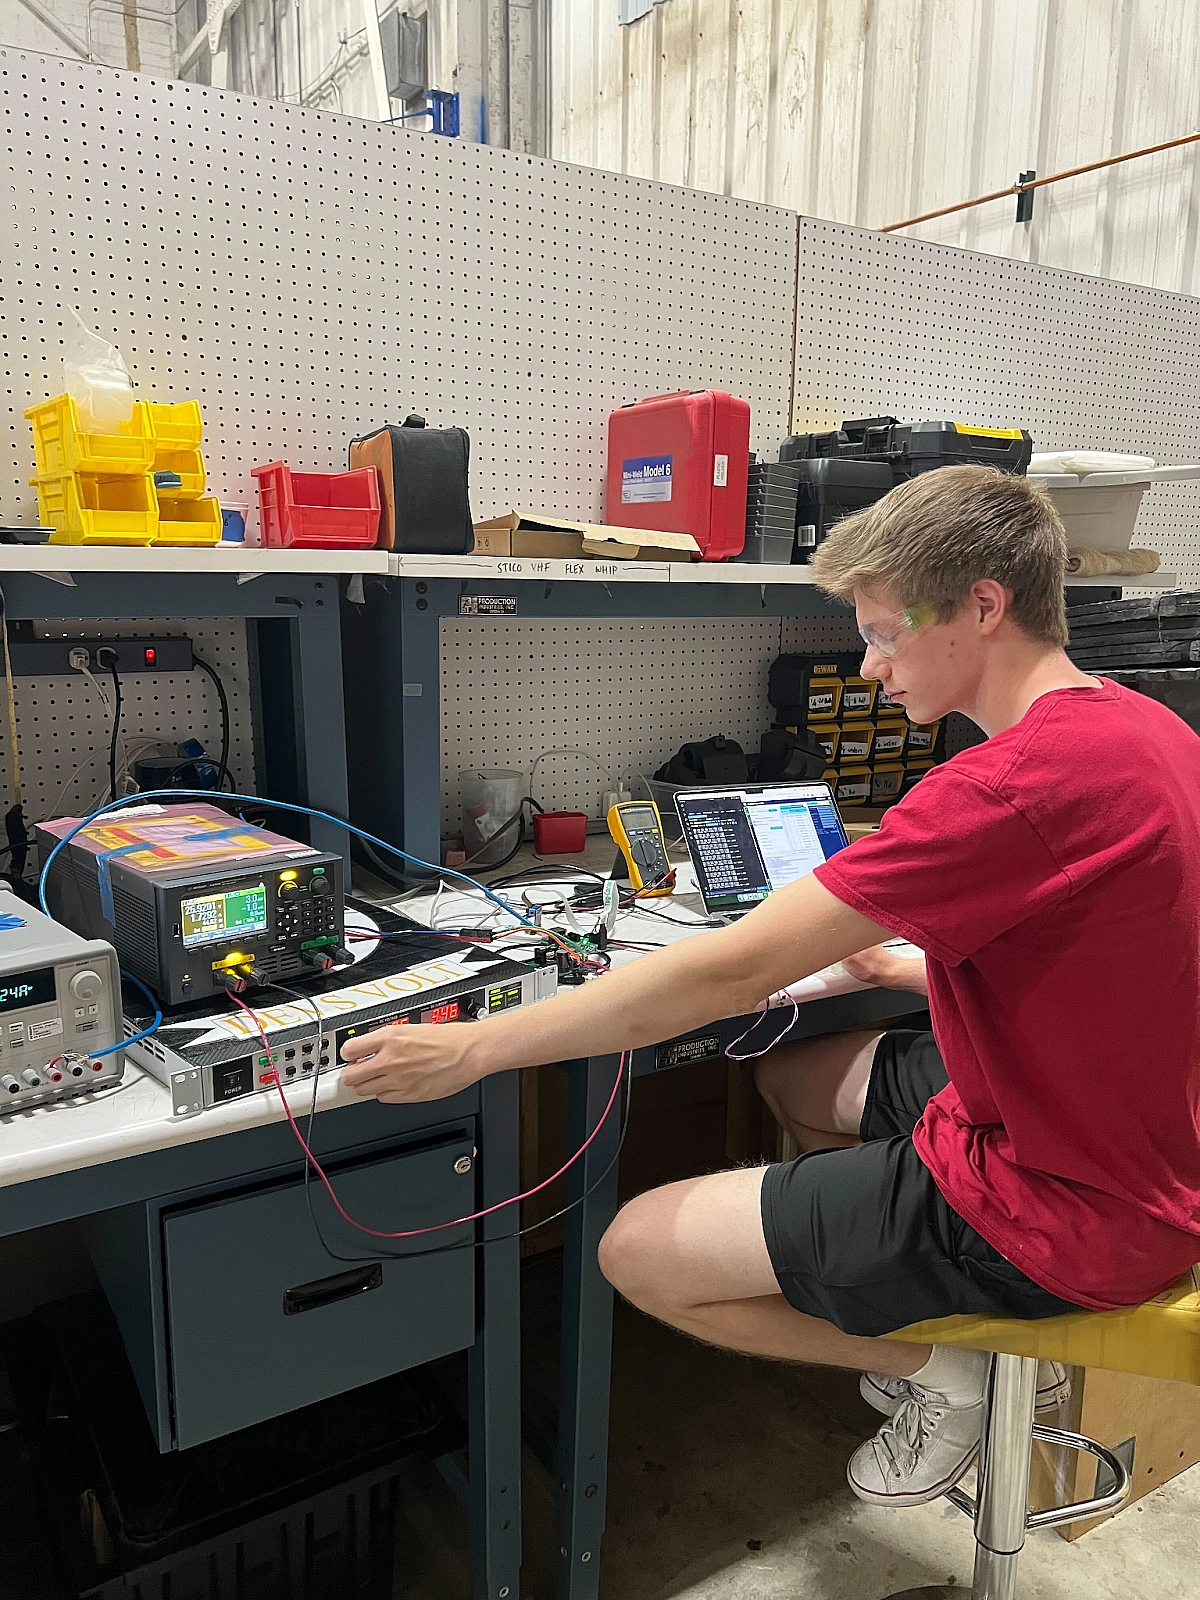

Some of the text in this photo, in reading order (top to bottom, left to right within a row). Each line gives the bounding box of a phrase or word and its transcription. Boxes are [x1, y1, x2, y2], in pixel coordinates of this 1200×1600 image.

[643, 464, 665, 478] Model
[665, 463, 671, 476] 6
[497, 561, 618, 576] STICO VHF FLEX WHIP
[478, 597, 516, 605] PRODUCTION
[349, 963, 465, 999] VOLT
[677, 1037, 720, 1053] PRODUCTION
[224, 1085, 242, 1096] POWER
